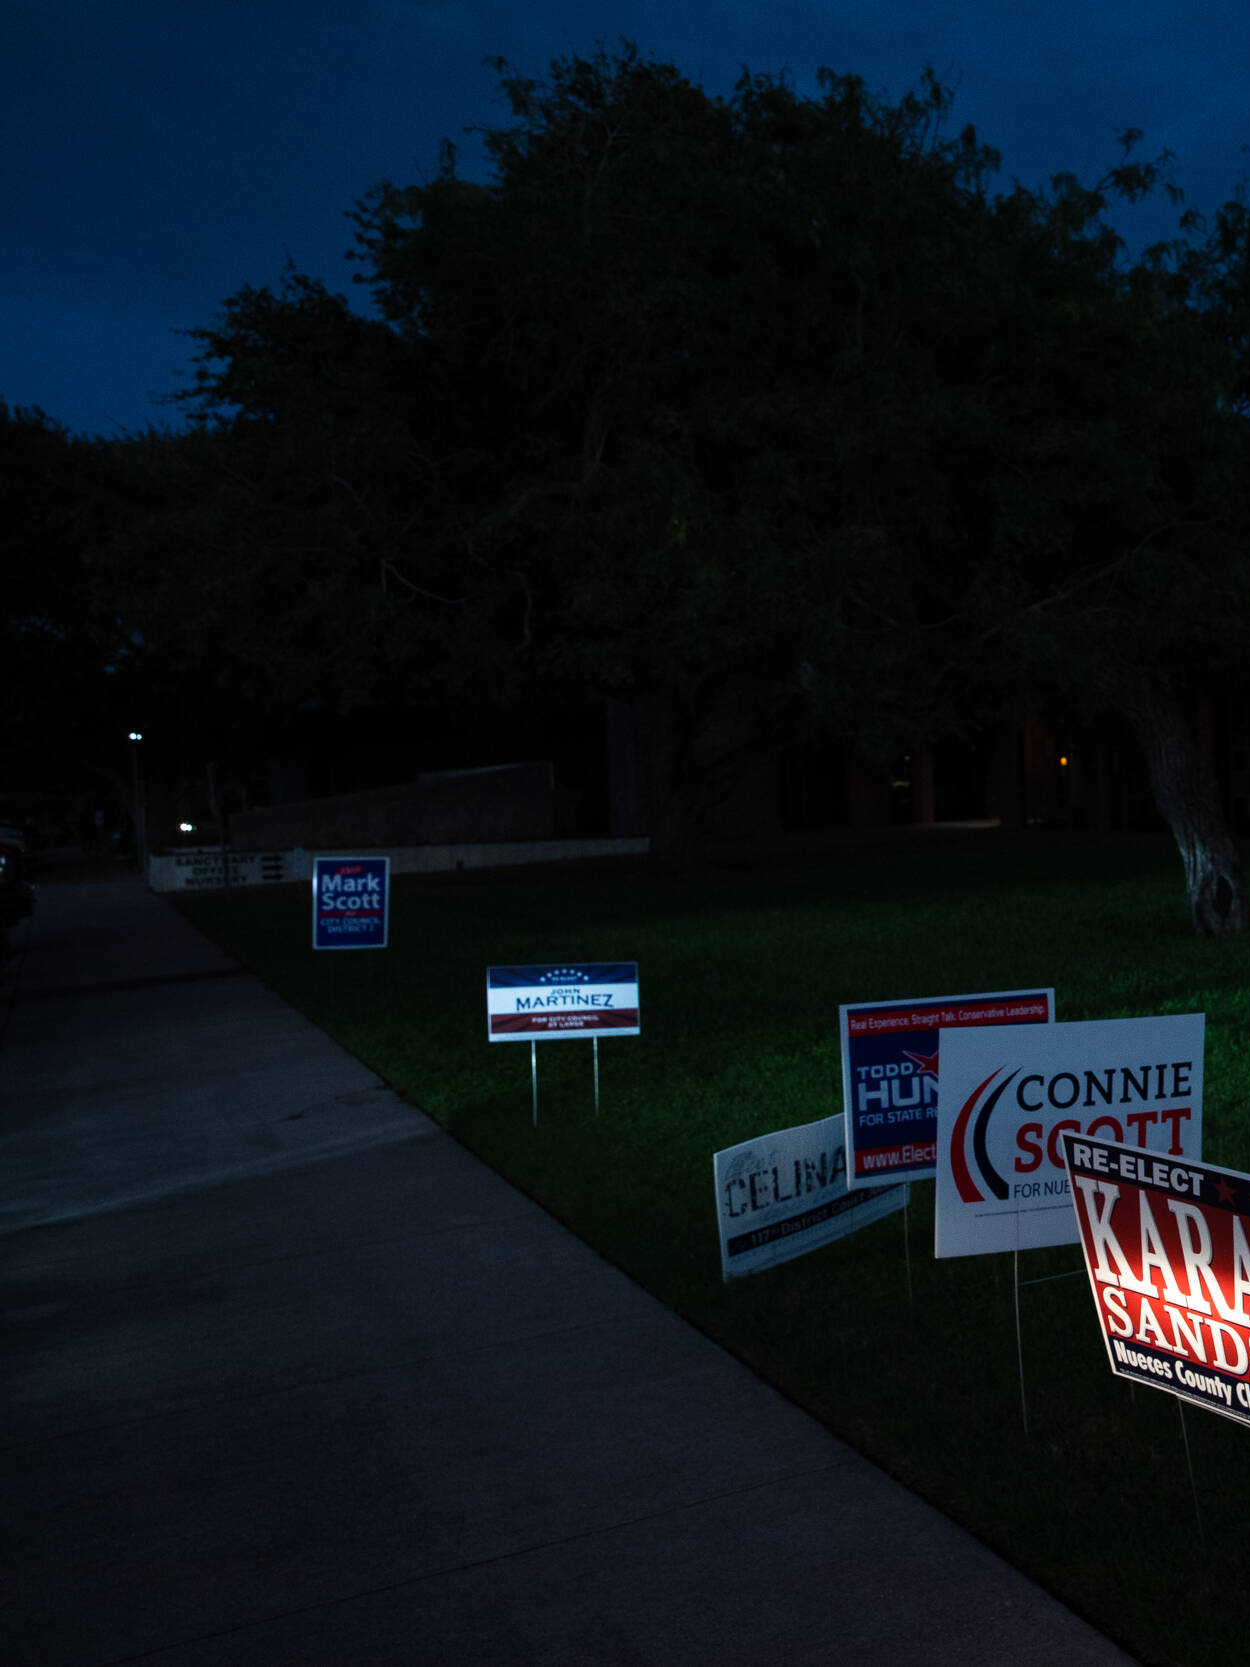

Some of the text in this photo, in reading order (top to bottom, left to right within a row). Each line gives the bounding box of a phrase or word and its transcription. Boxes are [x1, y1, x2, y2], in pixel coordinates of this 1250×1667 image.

[176, 855, 256, 866] SANCTARY
[185, 875, 248, 886] NURSRY
[321, 872, 381, 893] Mark
[321, 892, 381, 911] Scott
[551, 987, 581, 996] JOHN
[516, 993, 614, 1012] MARTINEZ
[531, 1014, 600, 1024] FOR CITY COUNCIL
[850, 1018, 867, 1031] Real
[911, 1012, 939, 1026] Straight
[958, 1008, 1005, 1021] Conservative
[857, 1062, 914, 1080] TODD
[1016, 1061, 1193, 1112] CONNIE
[859, 1112, 885, 1127] FOR
[887, 1108, 923, 1124] STATE
[1072, 1142, 1205, 1197] RE-ELECT
[1014, 1182, 1041, 1199] FOR
[780, 1206, 829, 1234] District
[1112, 1338, 1174, 1380] Nueces
[1174, 1360, 1233, 1407] County
